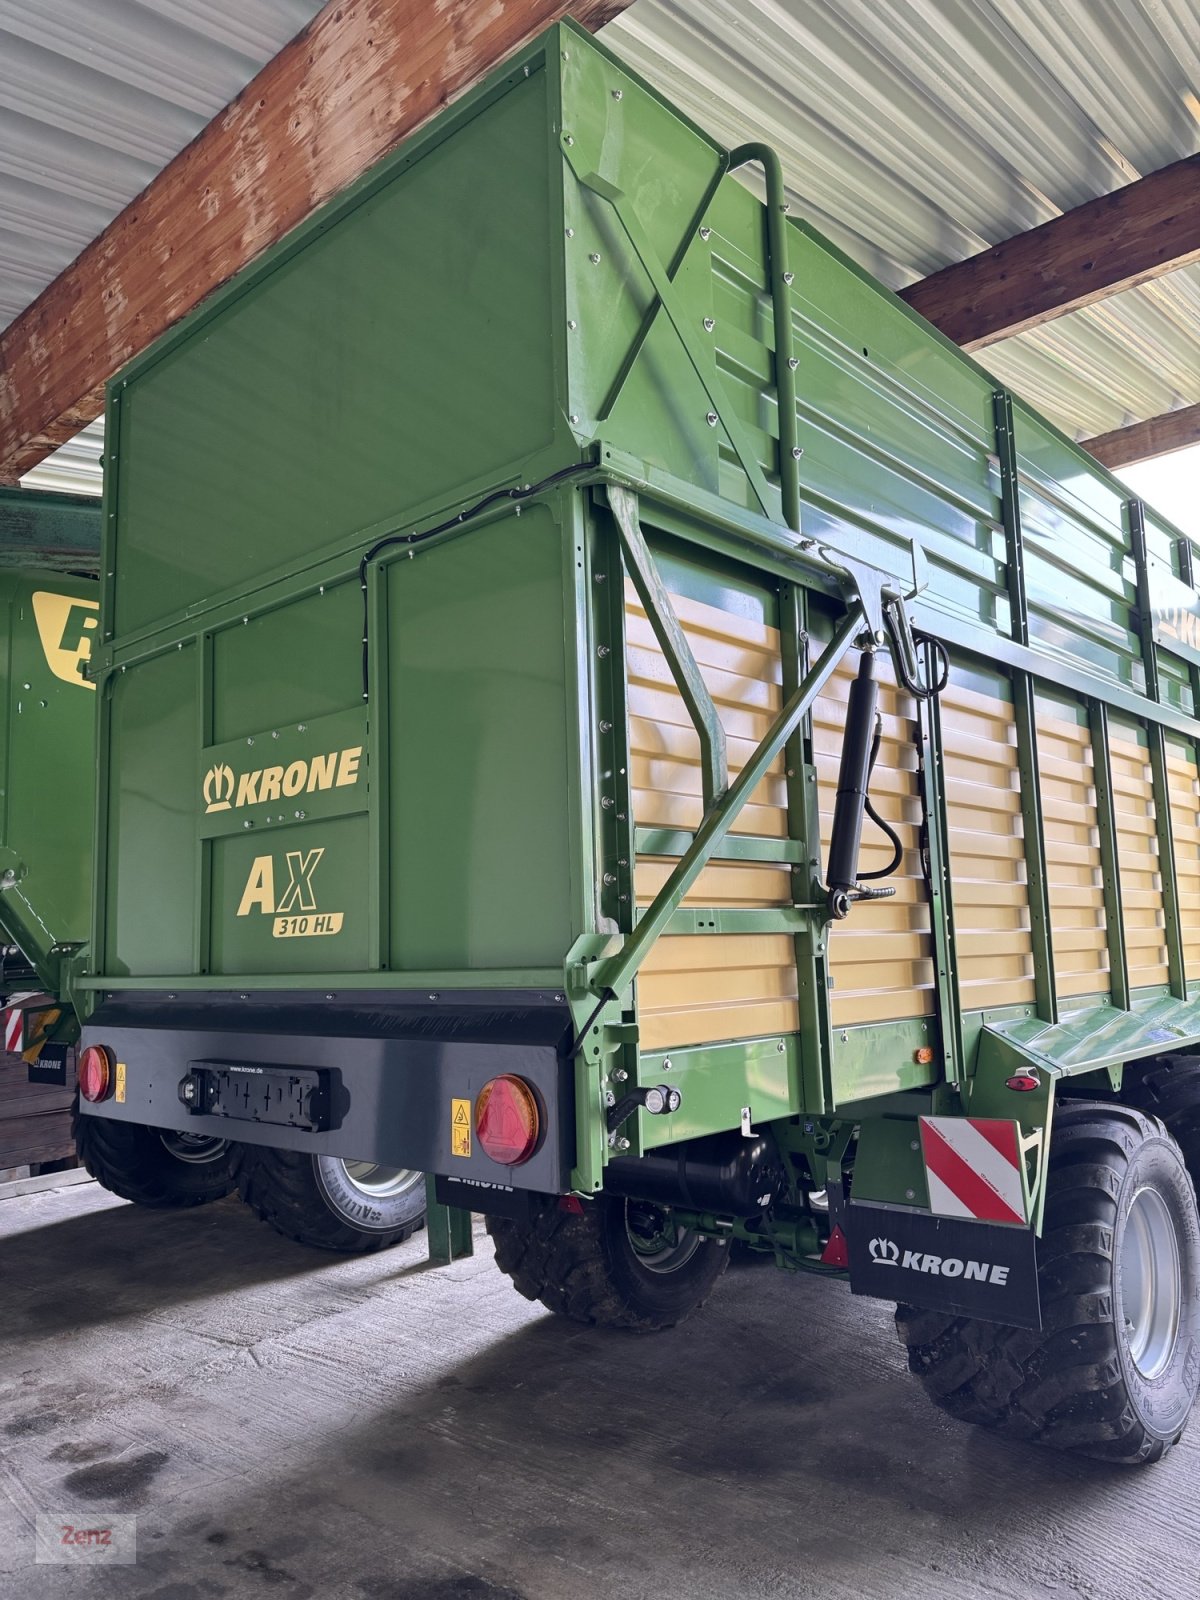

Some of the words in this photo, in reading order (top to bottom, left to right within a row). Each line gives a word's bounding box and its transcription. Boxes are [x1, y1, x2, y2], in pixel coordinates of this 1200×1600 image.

[235, 746, 363, 808] KRONE
[237, 848, 325, 917] AX
[278, 917, 309, 936] 310
[313, 915, 335, 933] HL
[40, 1059, 62, 1070] KRONE
[901, 1250, 1010, 1286] KRONE
